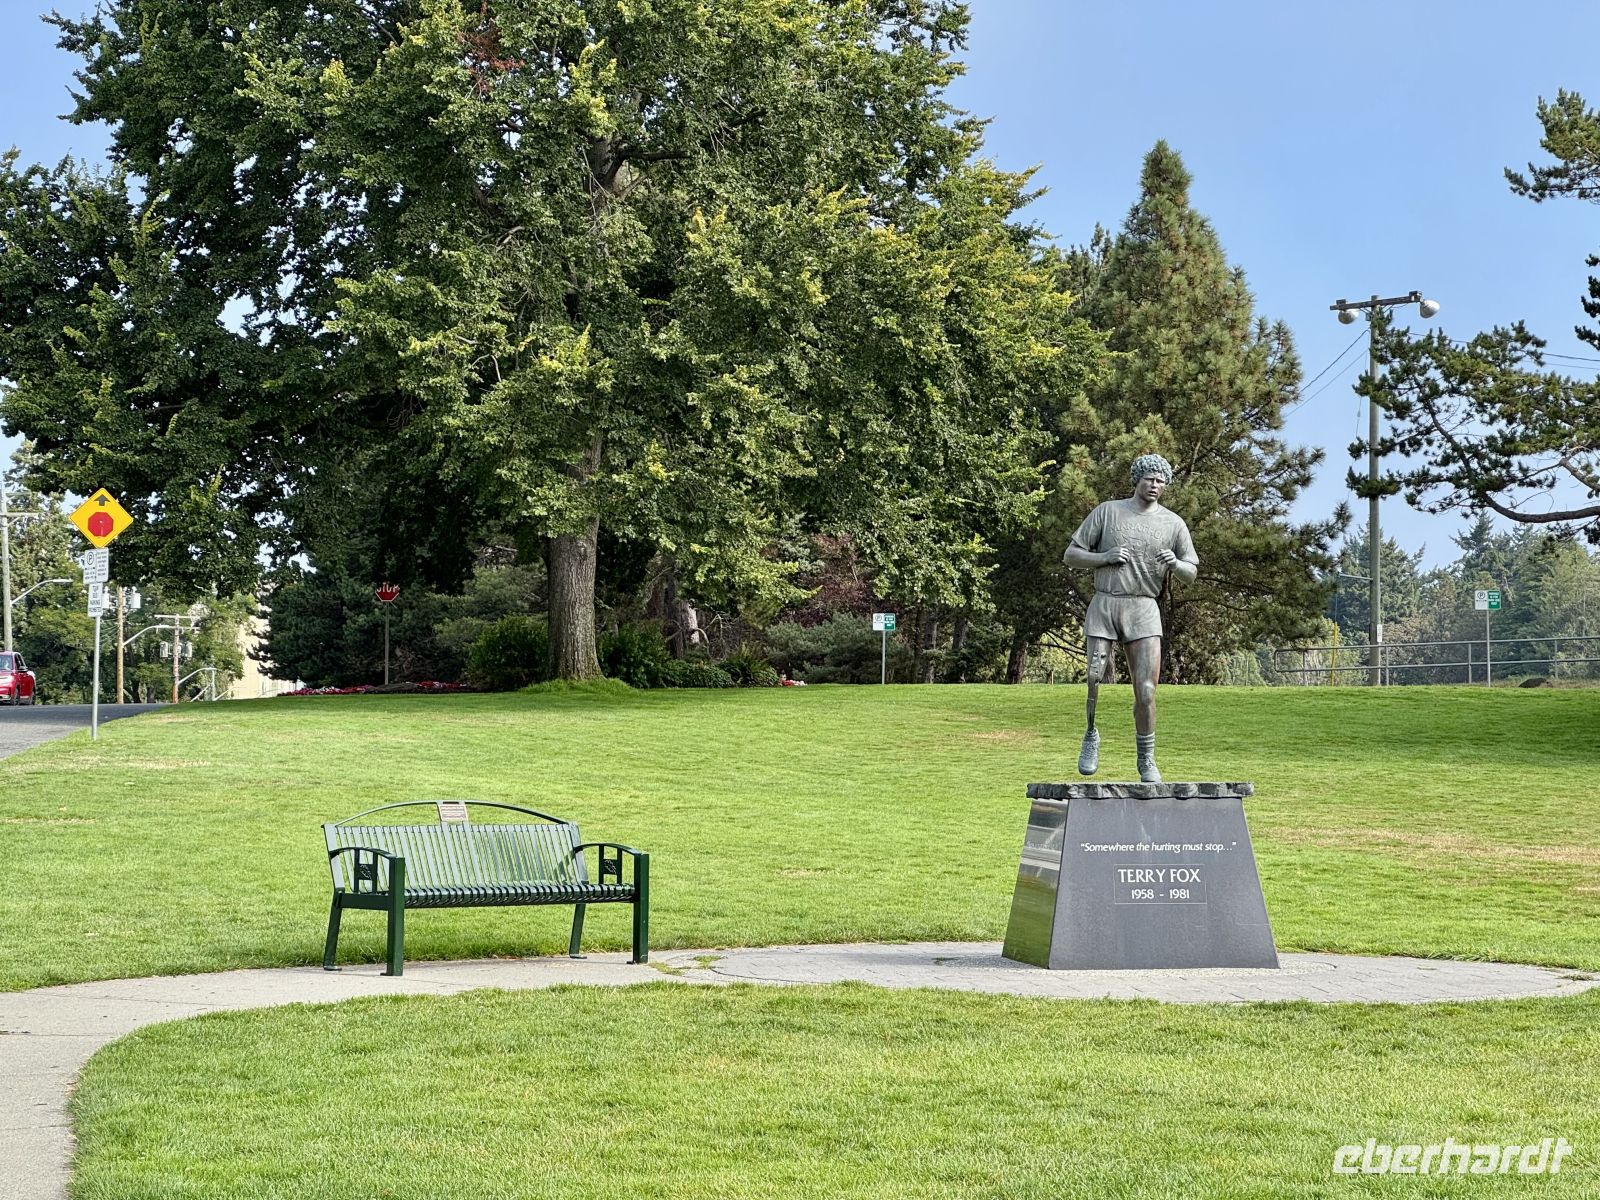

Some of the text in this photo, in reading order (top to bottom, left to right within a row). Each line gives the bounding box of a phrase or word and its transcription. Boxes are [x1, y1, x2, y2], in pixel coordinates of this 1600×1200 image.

[1080, 842, 1135, 852] "Somewhere
[1136, 842, 1150, 851] the
[1151, 842, 1181, 853] hurting
[1182, 843, 1203, 851] must
[1117, 868, 1201, 883] TERRY FOX
[1131, 888, 1155, 900] 1958
[1169, 888, 1190, 899] 1981
